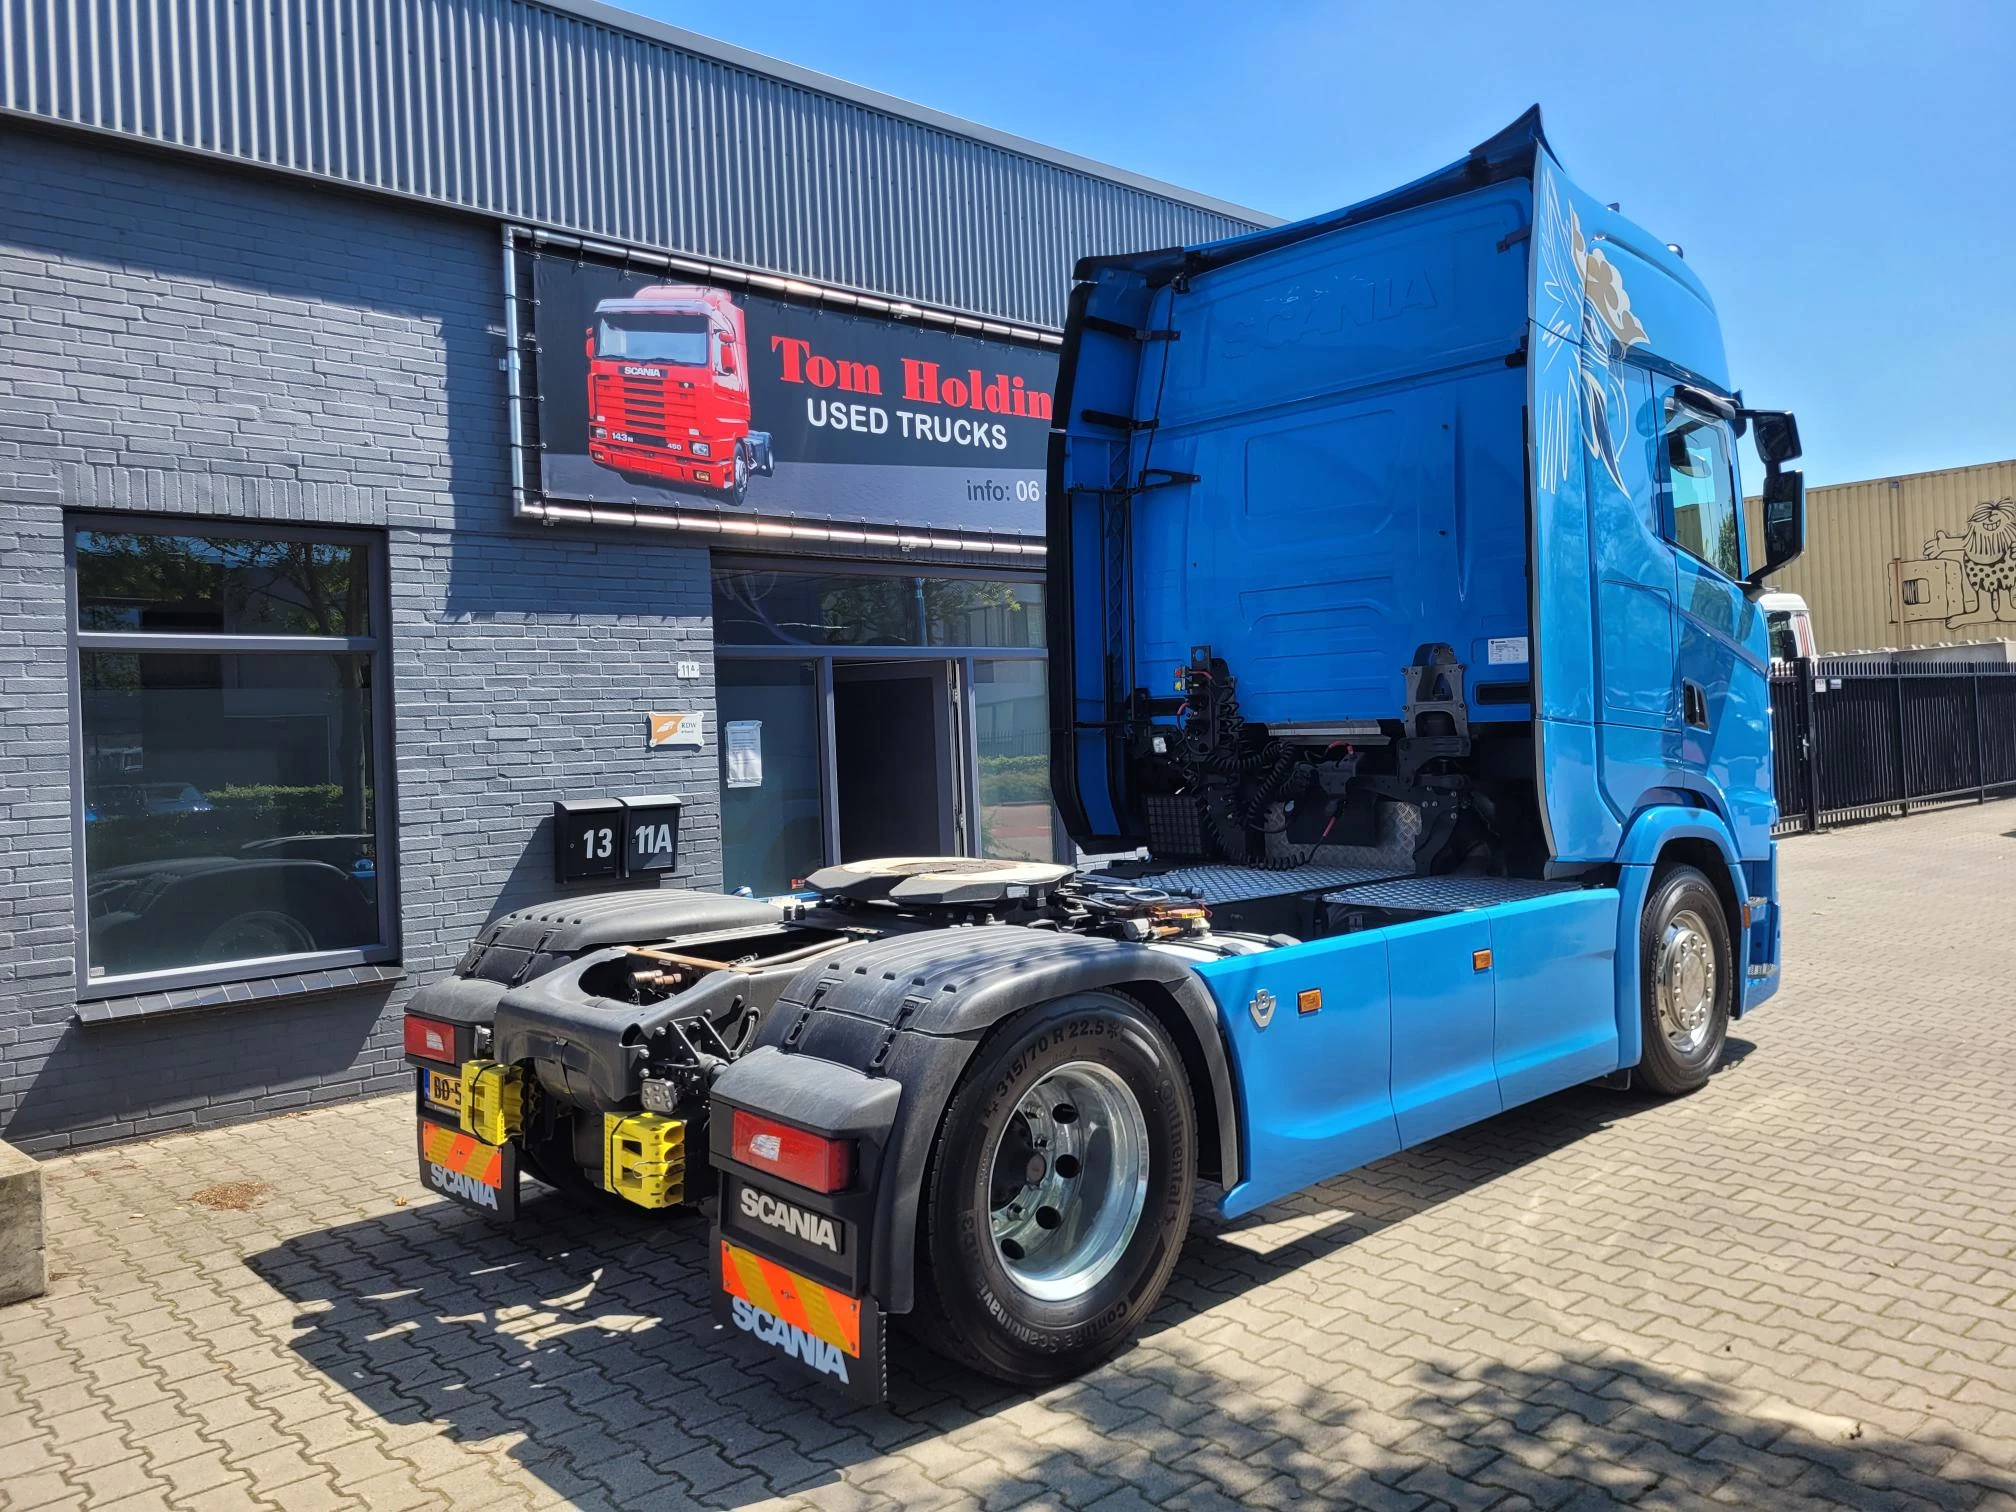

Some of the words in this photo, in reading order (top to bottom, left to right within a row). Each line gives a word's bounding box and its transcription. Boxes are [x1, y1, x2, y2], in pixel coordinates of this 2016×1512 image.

[1221, 269, 1440, 361] SCANIA
[624, 366, 661, 377] SCANIA
[771, 336, 883, 396] Tom
[667, 443, 682, 451] 450
[806, 398, 888, 435] USED
[896, 409, 1007, 450] TRUCKS
[966, 480, 1011, 501] info:
[1016, 480, 1040, 502] 06
[583, 828, 613, 859] 13
[635, 823, 673, 855] 11A
[996, 1035, 1049, 1098] 315/70
[1053, 1028, 1065, 1045] R
[1069, 1019, 1105, 1038] 22.5
[430, 1163, 498, 1211] SCANIA
[740, 1187, 838, 1252] SCANIA
[732, 1295, 850, 1385] SCANIA
